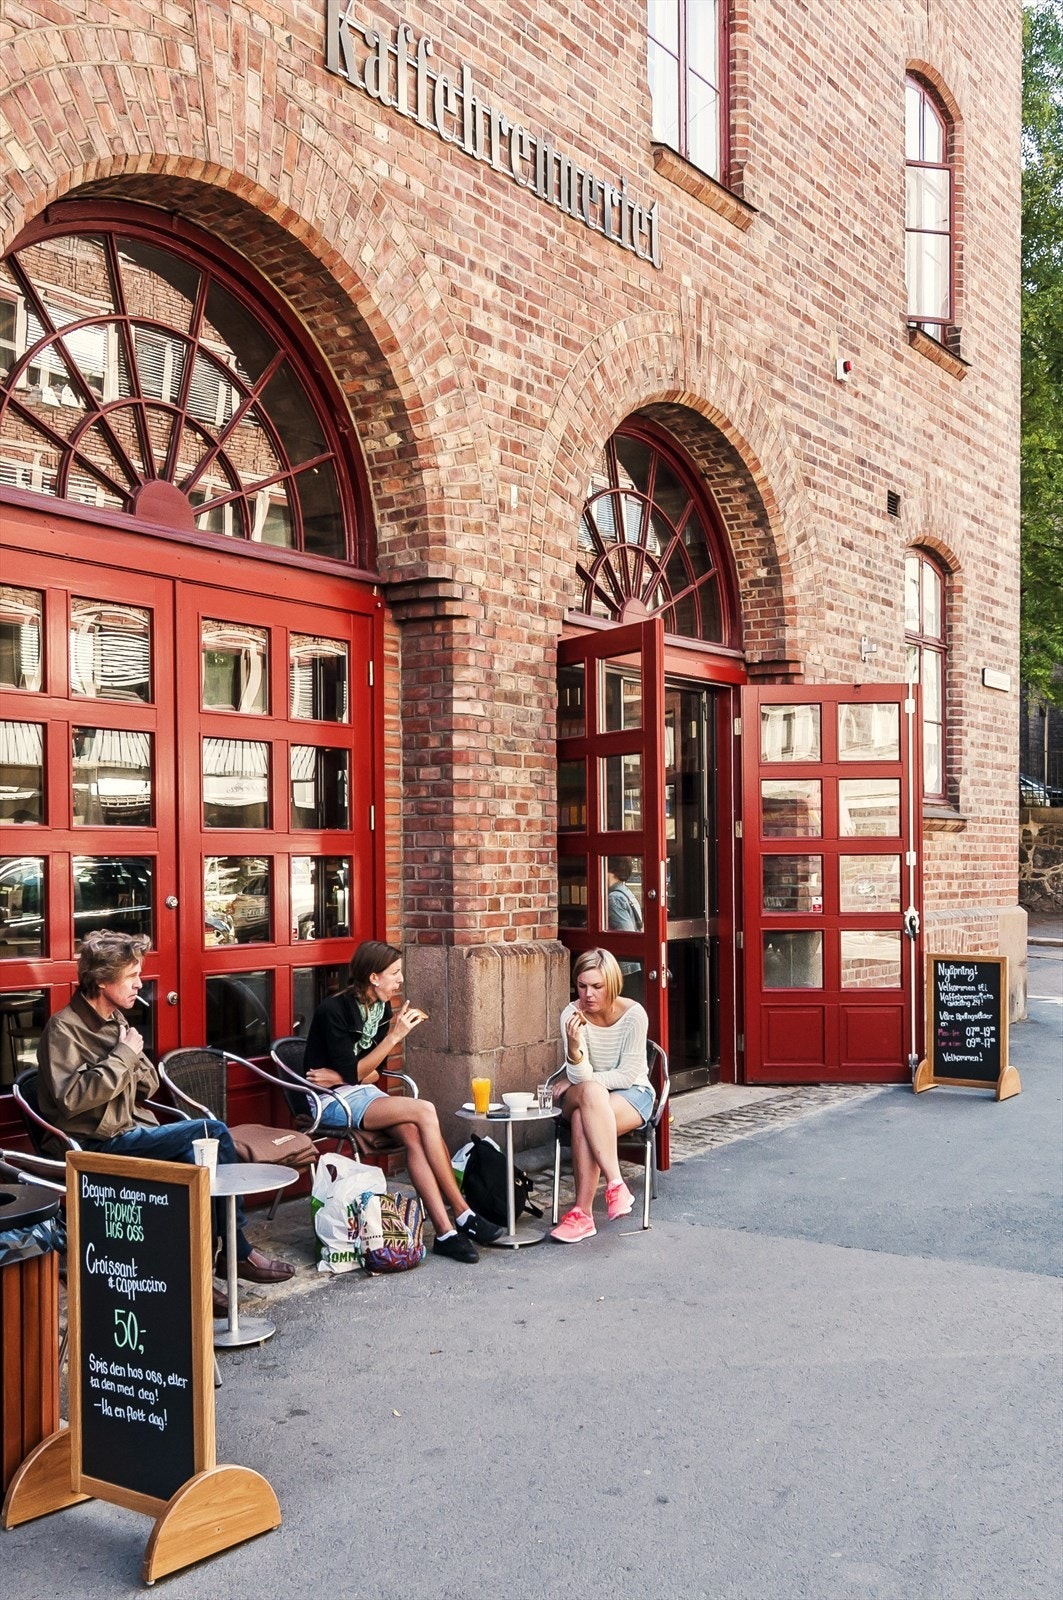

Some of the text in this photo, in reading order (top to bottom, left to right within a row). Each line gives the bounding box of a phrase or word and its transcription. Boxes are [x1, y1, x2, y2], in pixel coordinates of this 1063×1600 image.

[324, 0, 662, 270] Kaffebrenneriet
[938, 962, 978, 983] Nyåpning!
[938, 981, 976, 992] Velkommen
[82, 1174, 169, 1206] Begynn dagen med
[104, 1201, 142, 1224] FROKOST
[105, 1221, 144, 1241] HOS OSS
[86, 1242, 138, 1278] Croissant
[89, 1352, 188, 1388] Spis den hos oss, eller
[90, 1376, 159, 1405] ta den med deg!
[115, 1406, 126, 1418] en
[126, 1405, 146, 1422] flott
[148, 1408, 168, 1432] dag!
